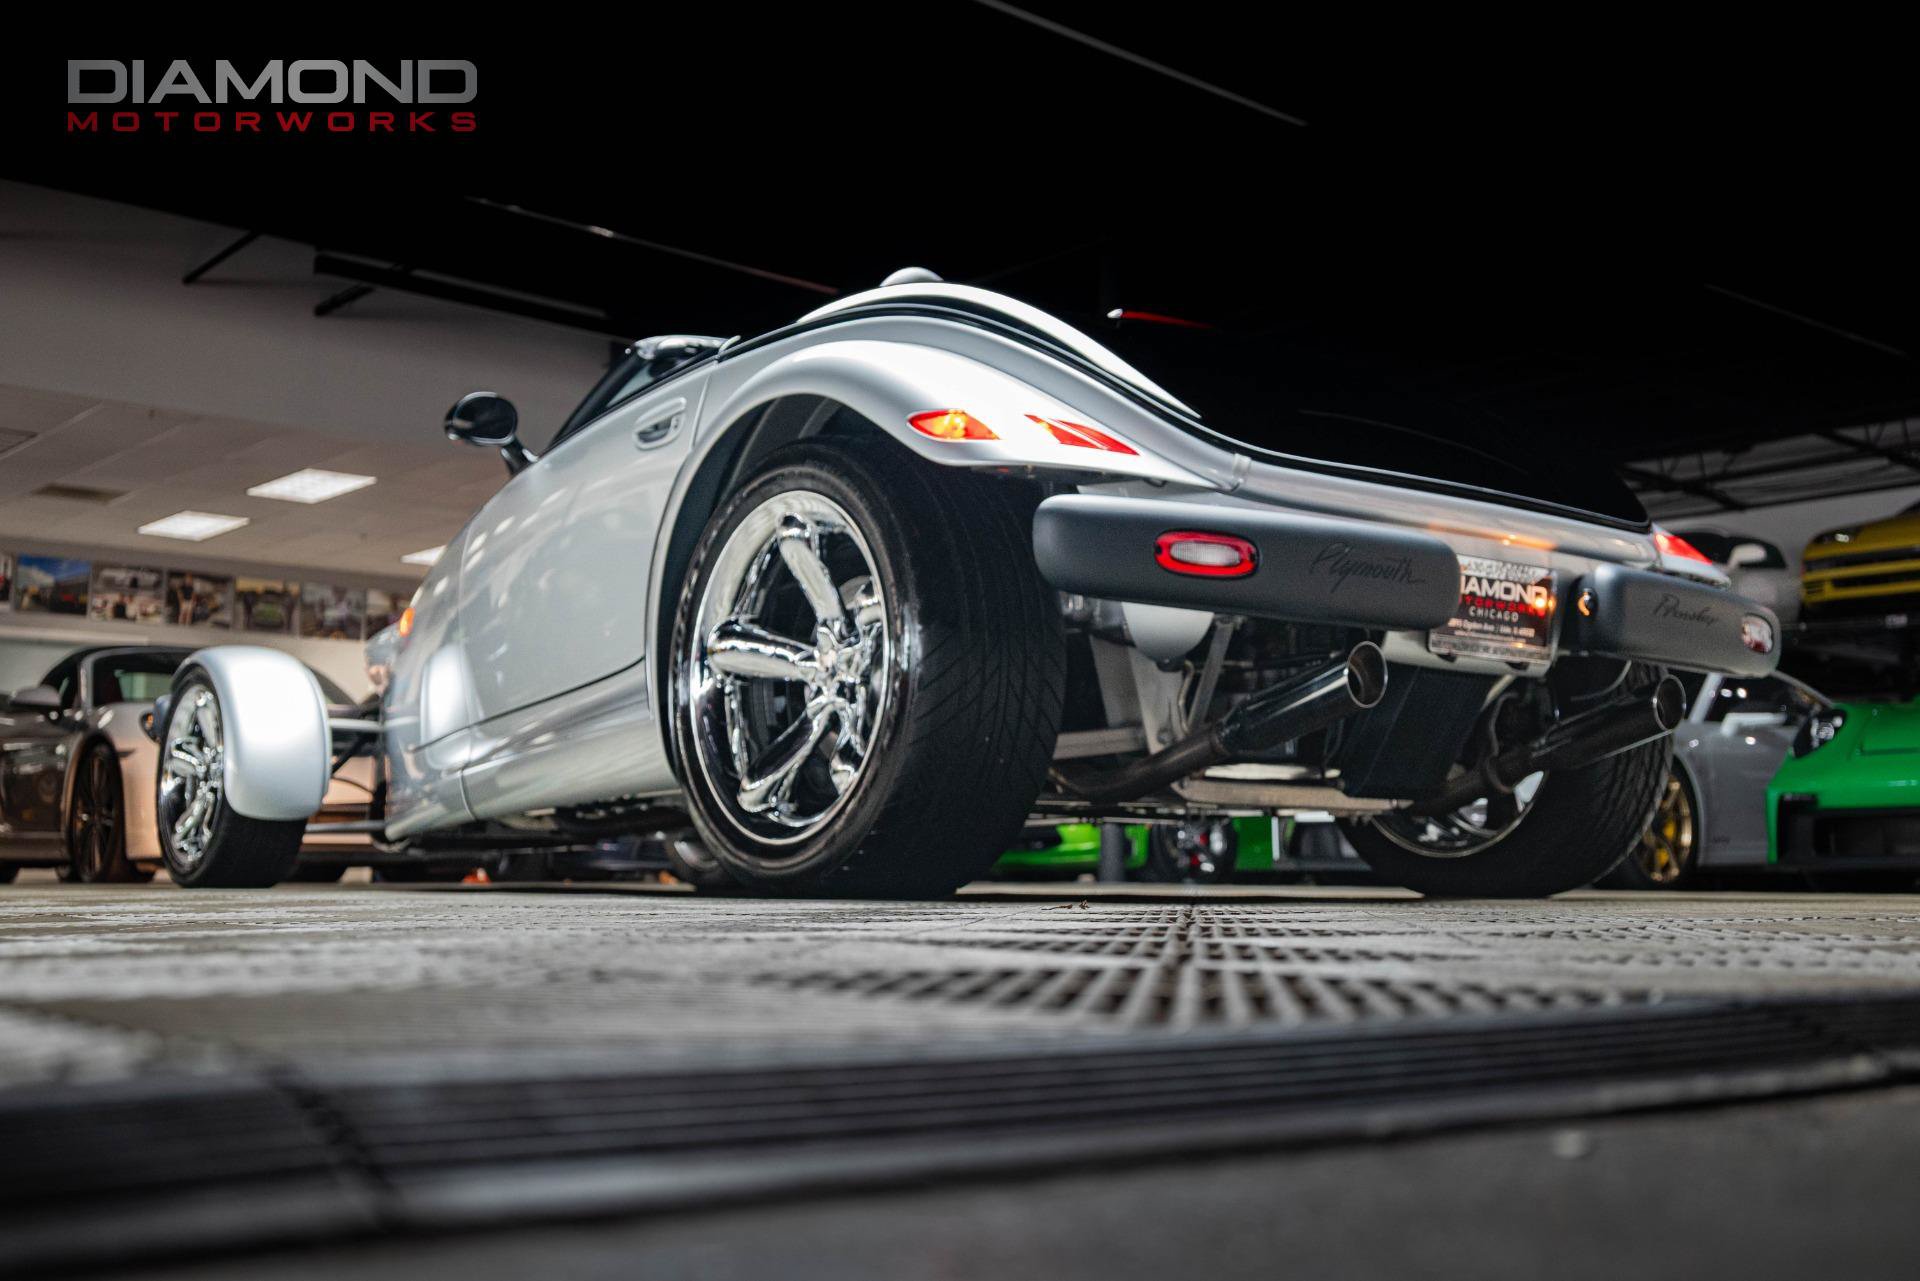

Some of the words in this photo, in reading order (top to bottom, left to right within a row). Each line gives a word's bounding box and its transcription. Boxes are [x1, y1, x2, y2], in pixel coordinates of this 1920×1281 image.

[1309, 541, 1425, 593] Plymouth
[1460, 574, 1548, 606] IAMOND
[1468, 605, 1519, 622] CHICAGO
